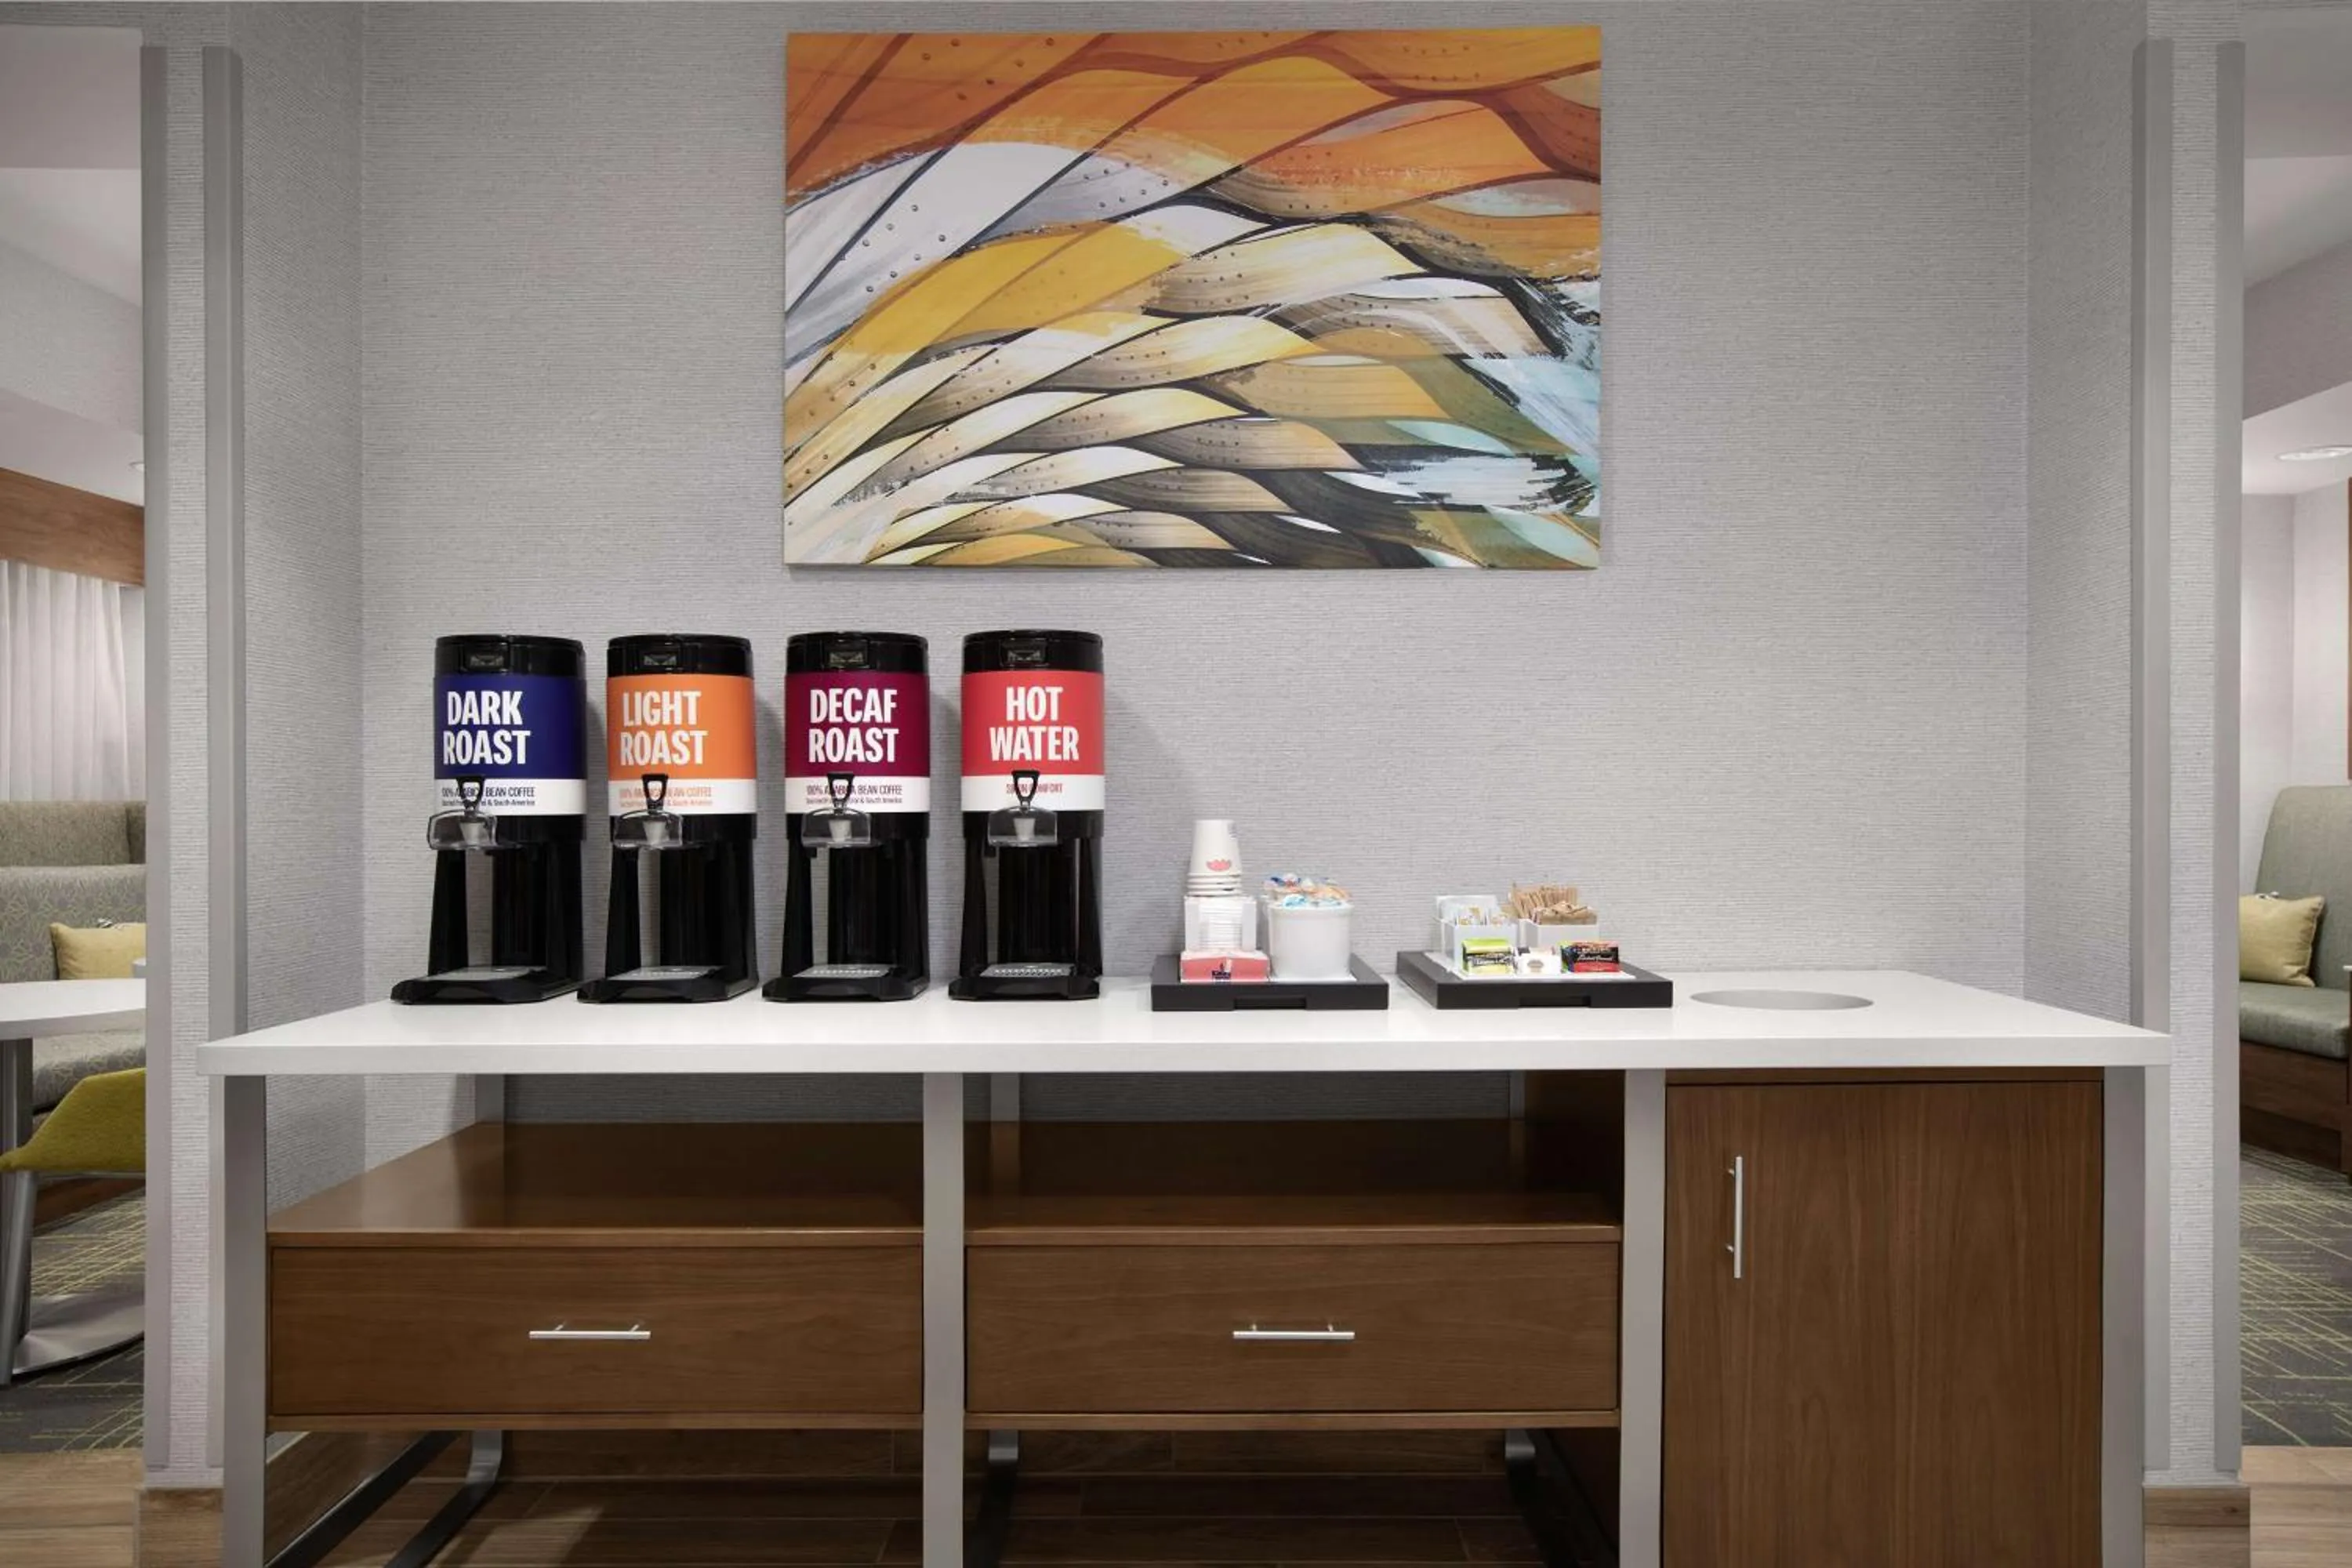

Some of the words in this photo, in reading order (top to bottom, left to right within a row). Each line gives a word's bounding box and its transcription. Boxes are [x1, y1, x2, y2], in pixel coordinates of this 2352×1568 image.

[448, 691, 523, 725] DARK
[623, 690, 702, 726] LIGHT
[810, 688, 898, 723] DECAF
[1006, 686, 1064, 721] HOT
[443, 729, 531, 765] ROAST
[621, 729, 709, 766] ROAST
[808, 727, 899, 763] ROAST
[989, 725, 1080, 761] WATER
[485, 786, 506, 797] BEAN
[508, 786, 535, 797] COFFEE
[858, 785, 877, 795] BEAN
[879, 785, 902, 795] COFFEE
